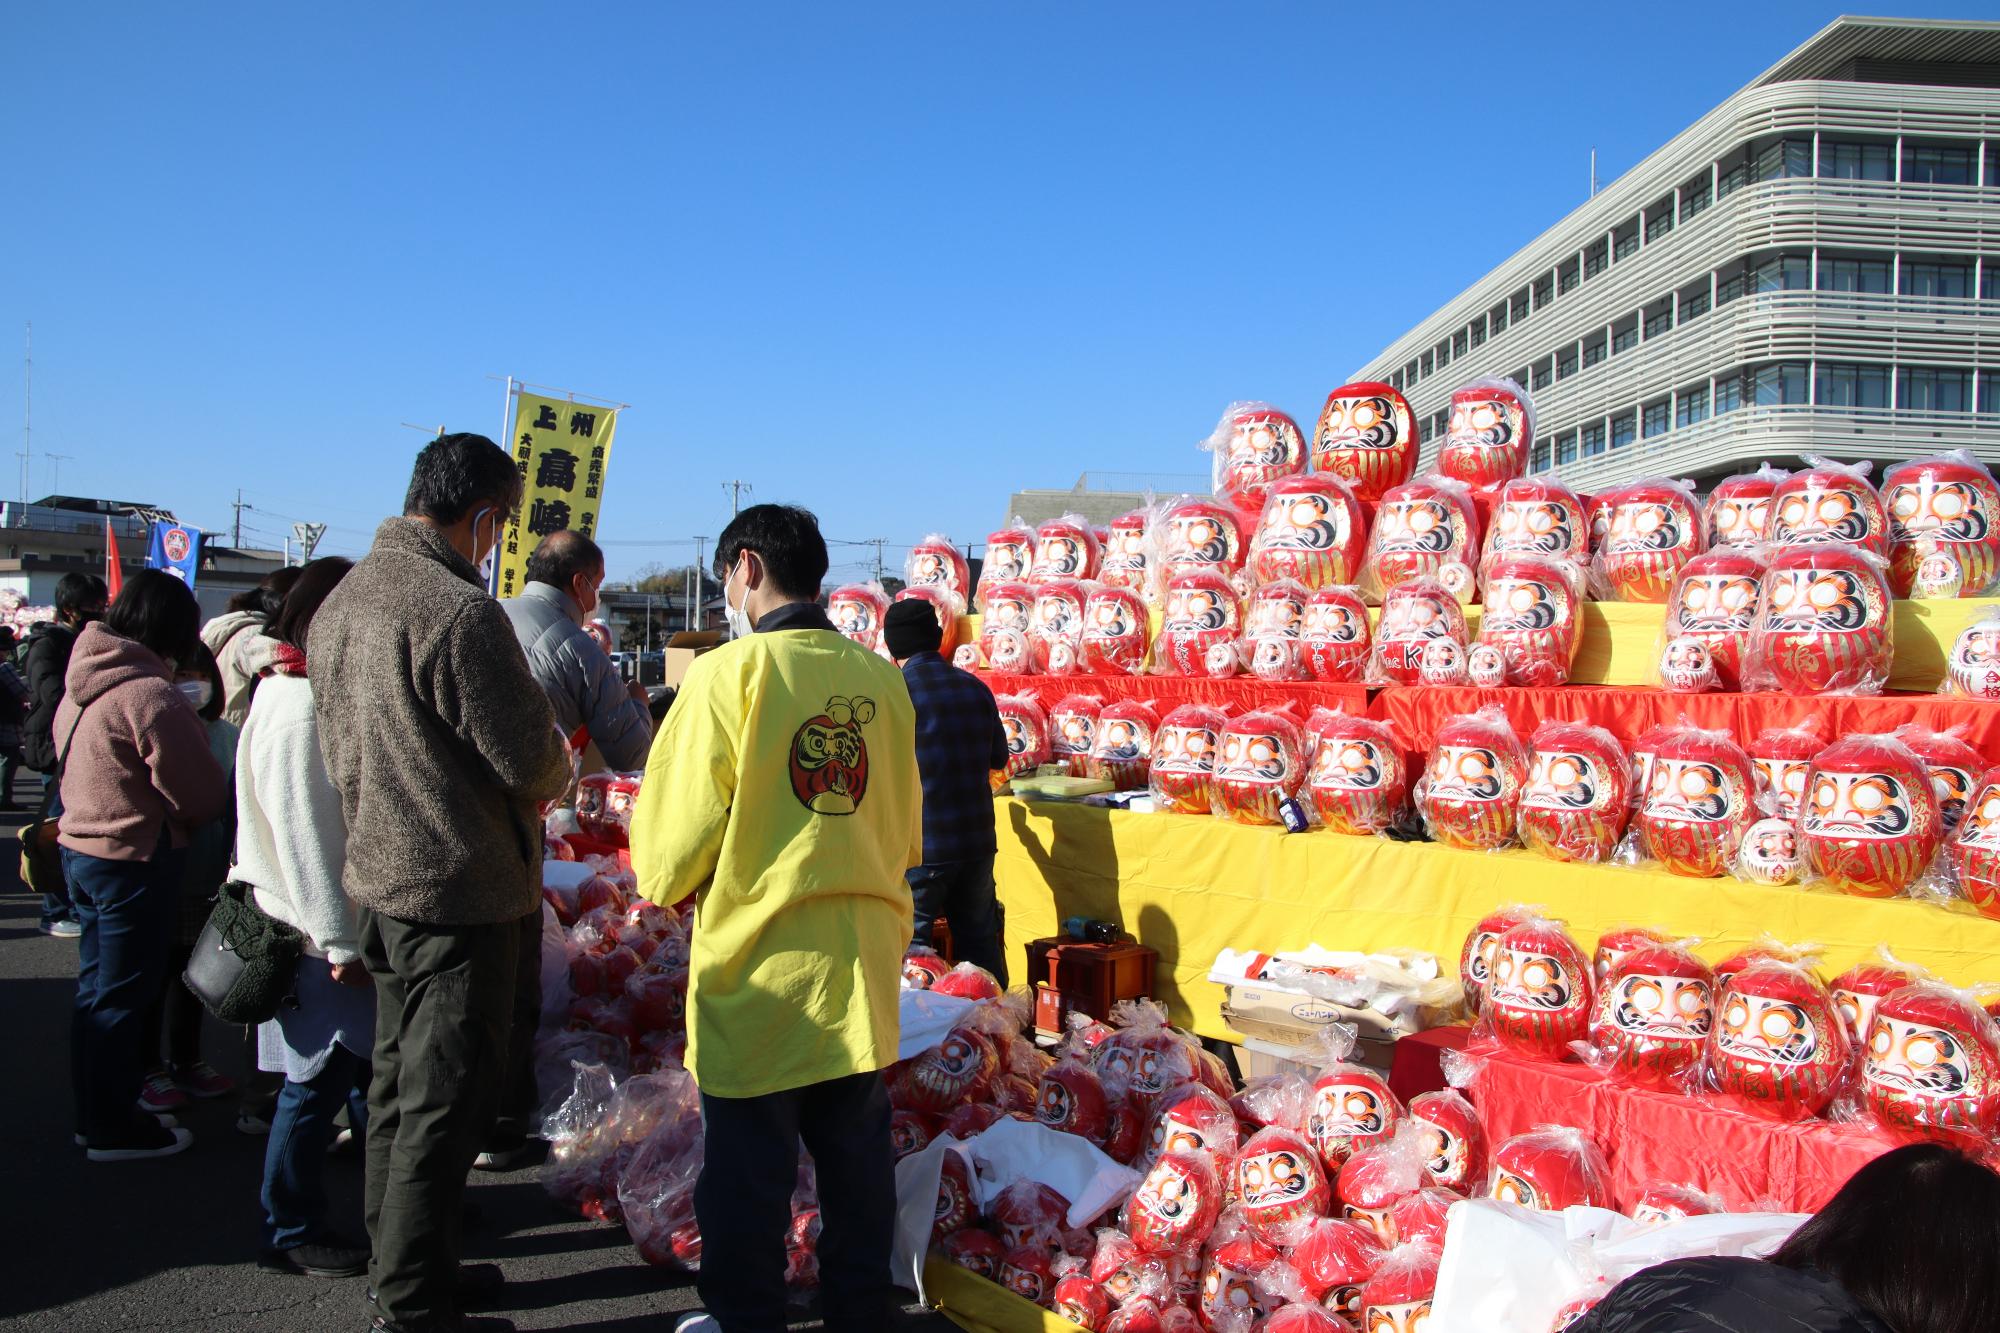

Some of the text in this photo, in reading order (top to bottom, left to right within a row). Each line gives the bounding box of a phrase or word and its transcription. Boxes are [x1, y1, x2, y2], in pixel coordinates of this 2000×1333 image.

[533, 404, 596, 438] 上州
[517, 432, 532, 487] 大願成
[584, 445, 606, 500] 商売繁盛
[503, 567, 515, 599] 学業
